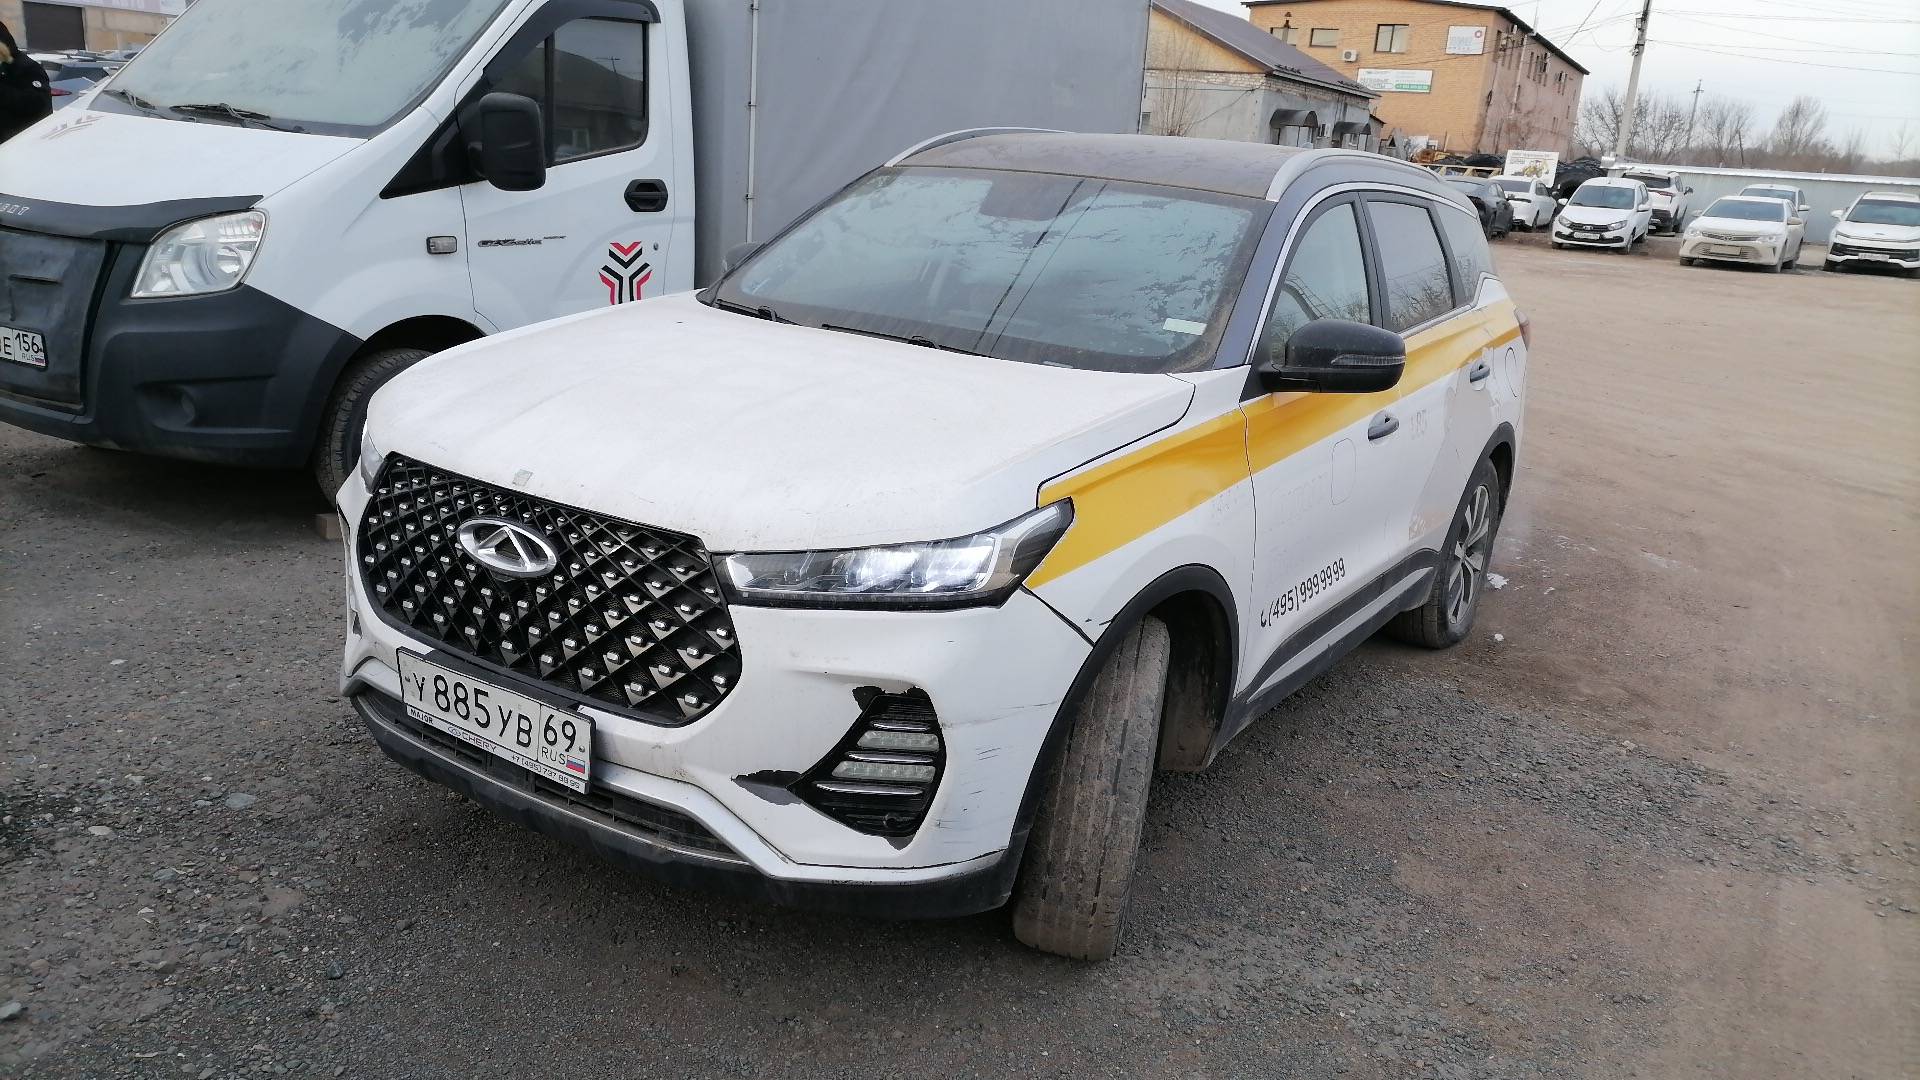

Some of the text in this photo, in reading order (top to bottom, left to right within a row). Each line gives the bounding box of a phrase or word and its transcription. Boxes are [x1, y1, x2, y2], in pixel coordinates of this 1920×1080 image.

[15, 332, 40, 354] 156
[410, 708, 434, 725] MAJOR
[462, 731, 497, 752] CHERY
[543, 713, 577, 752] 69
[541, 746, 566, 765] RUS
